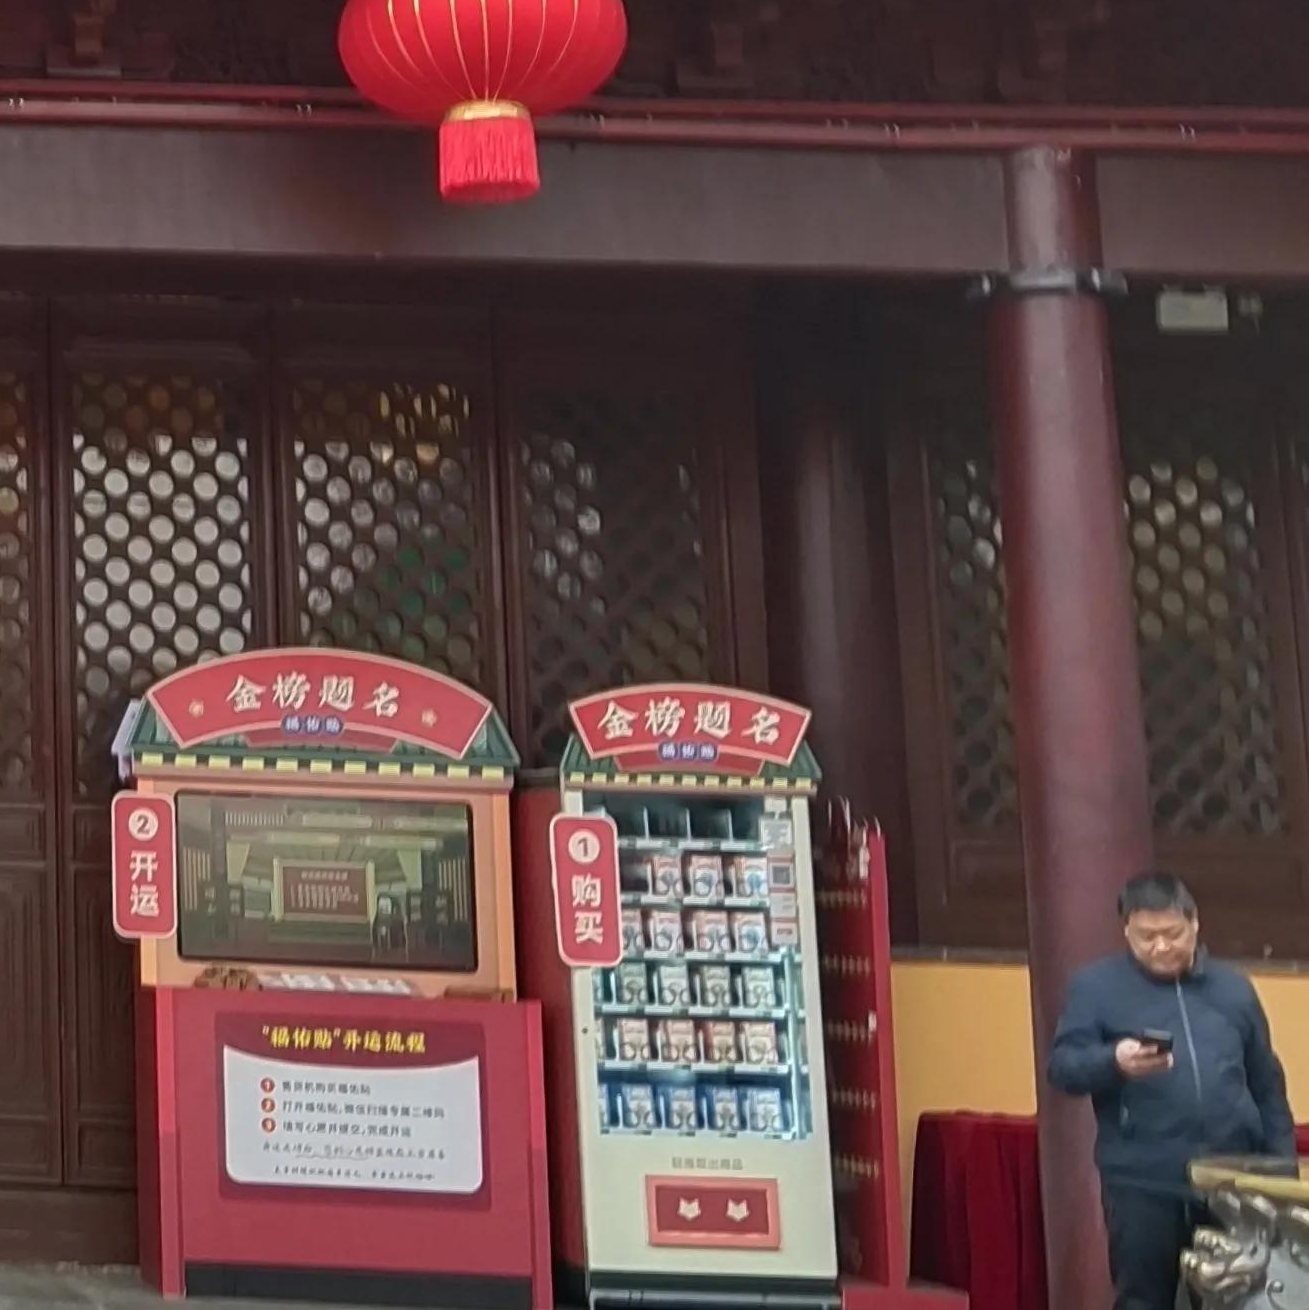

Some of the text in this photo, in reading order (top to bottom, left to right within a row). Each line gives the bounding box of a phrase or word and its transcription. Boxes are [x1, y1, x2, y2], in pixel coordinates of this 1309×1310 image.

[226, 670, 400, 718] 金榜题名
[596, 695, 783, 746] 金榜题名
[129, 849, 160, 918] 开运
[572, 872, 604, 945] 购买
